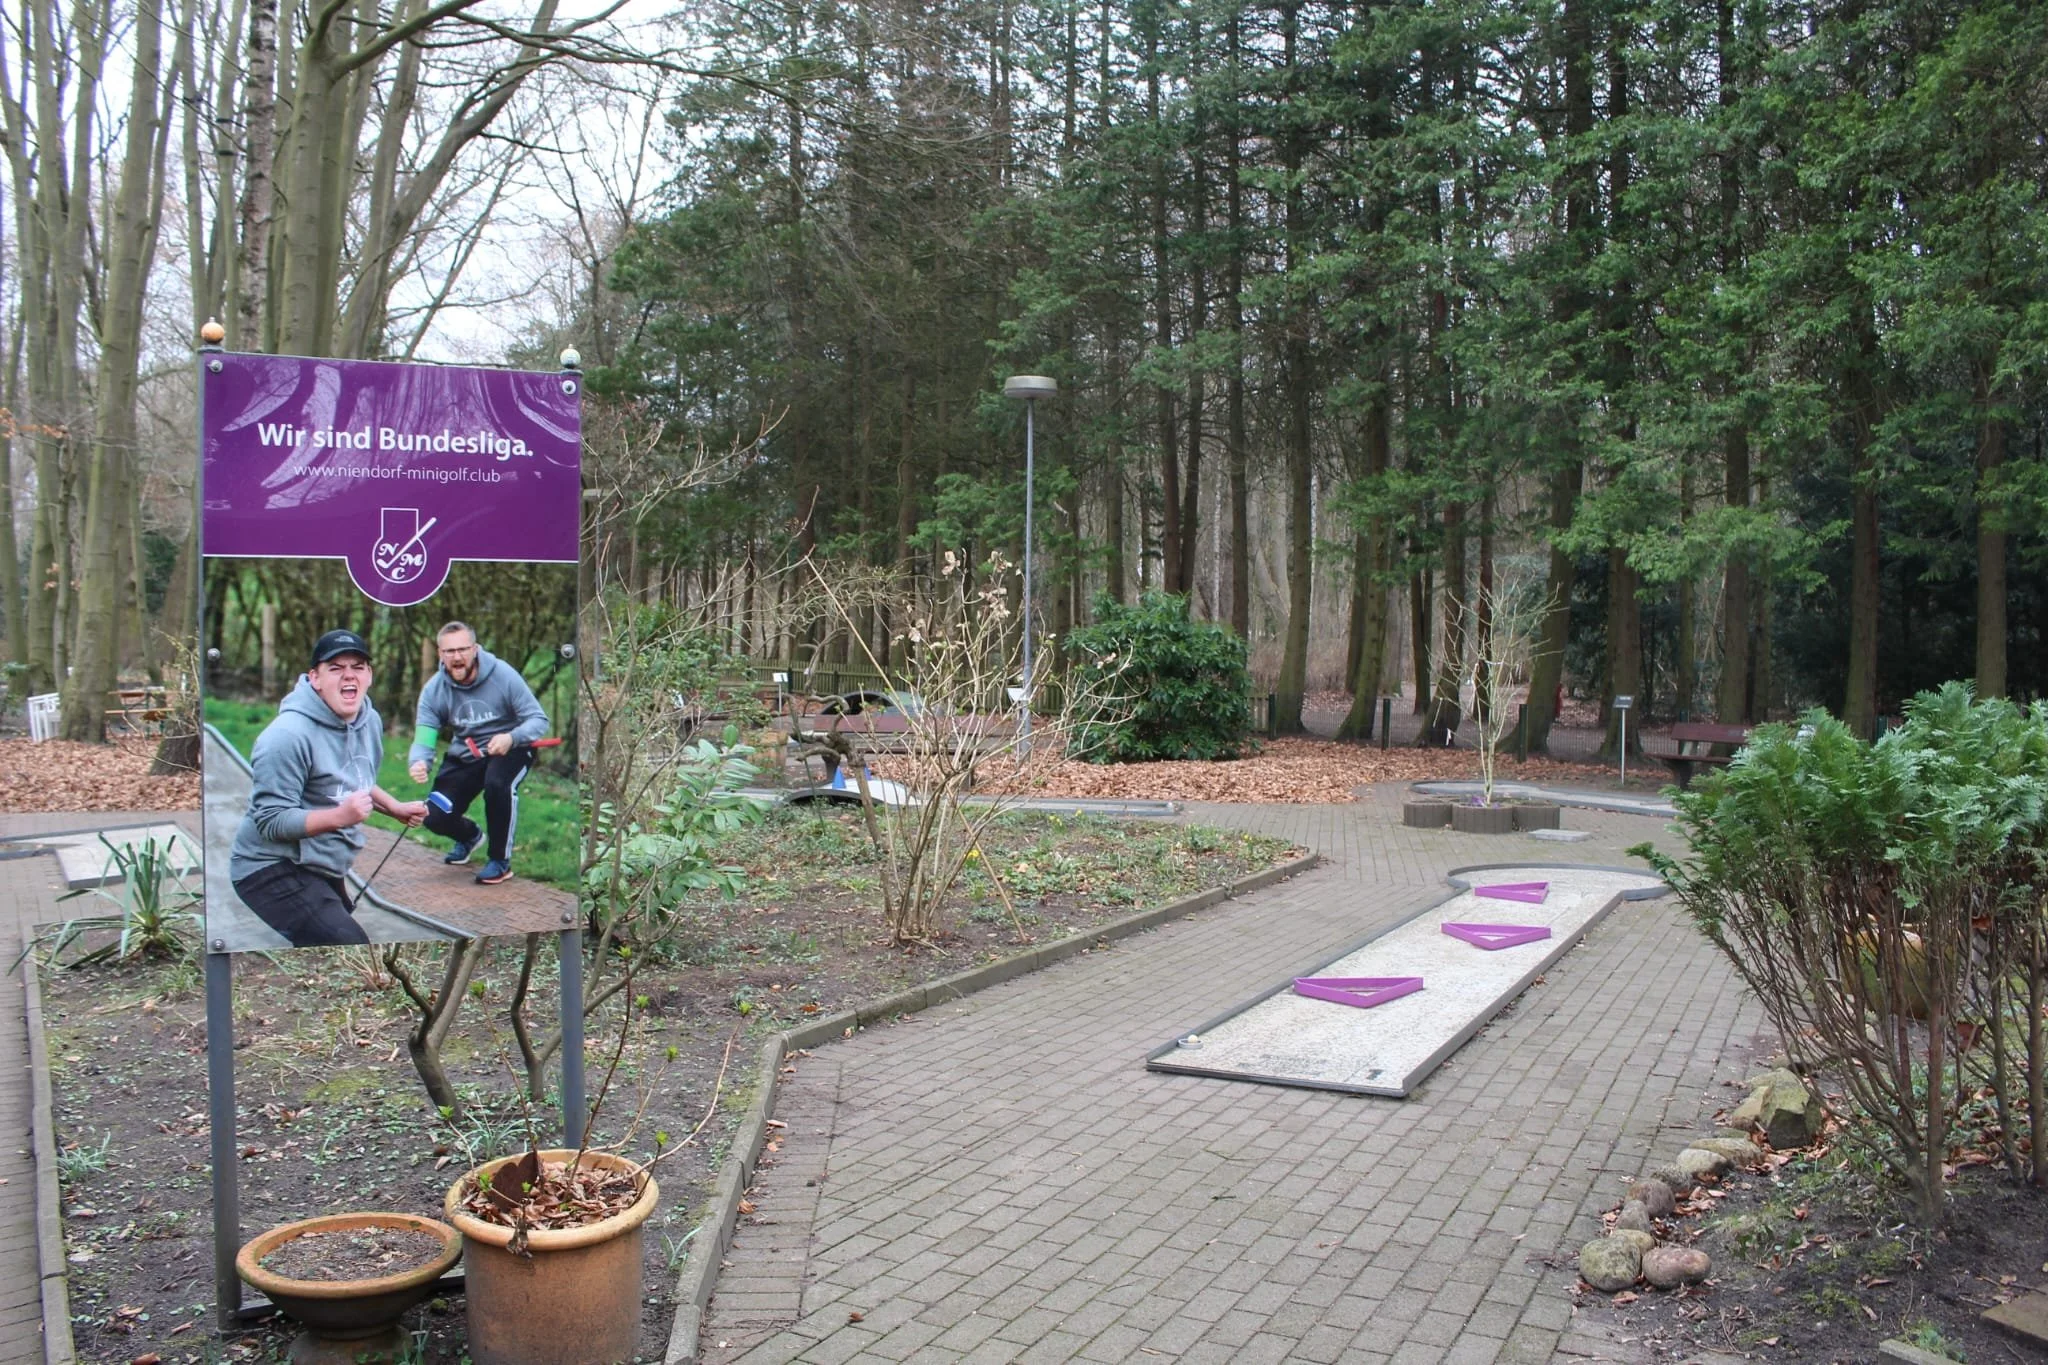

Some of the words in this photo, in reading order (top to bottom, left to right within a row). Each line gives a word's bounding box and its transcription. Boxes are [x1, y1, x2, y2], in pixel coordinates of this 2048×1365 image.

[257, 423, 306, 447] Wir
[313, 426, 370, 449] sind
[379, 427, 534, 461] Bundesliga.
[294, 465, 501, 484] www.niendorf-minigolf.club
